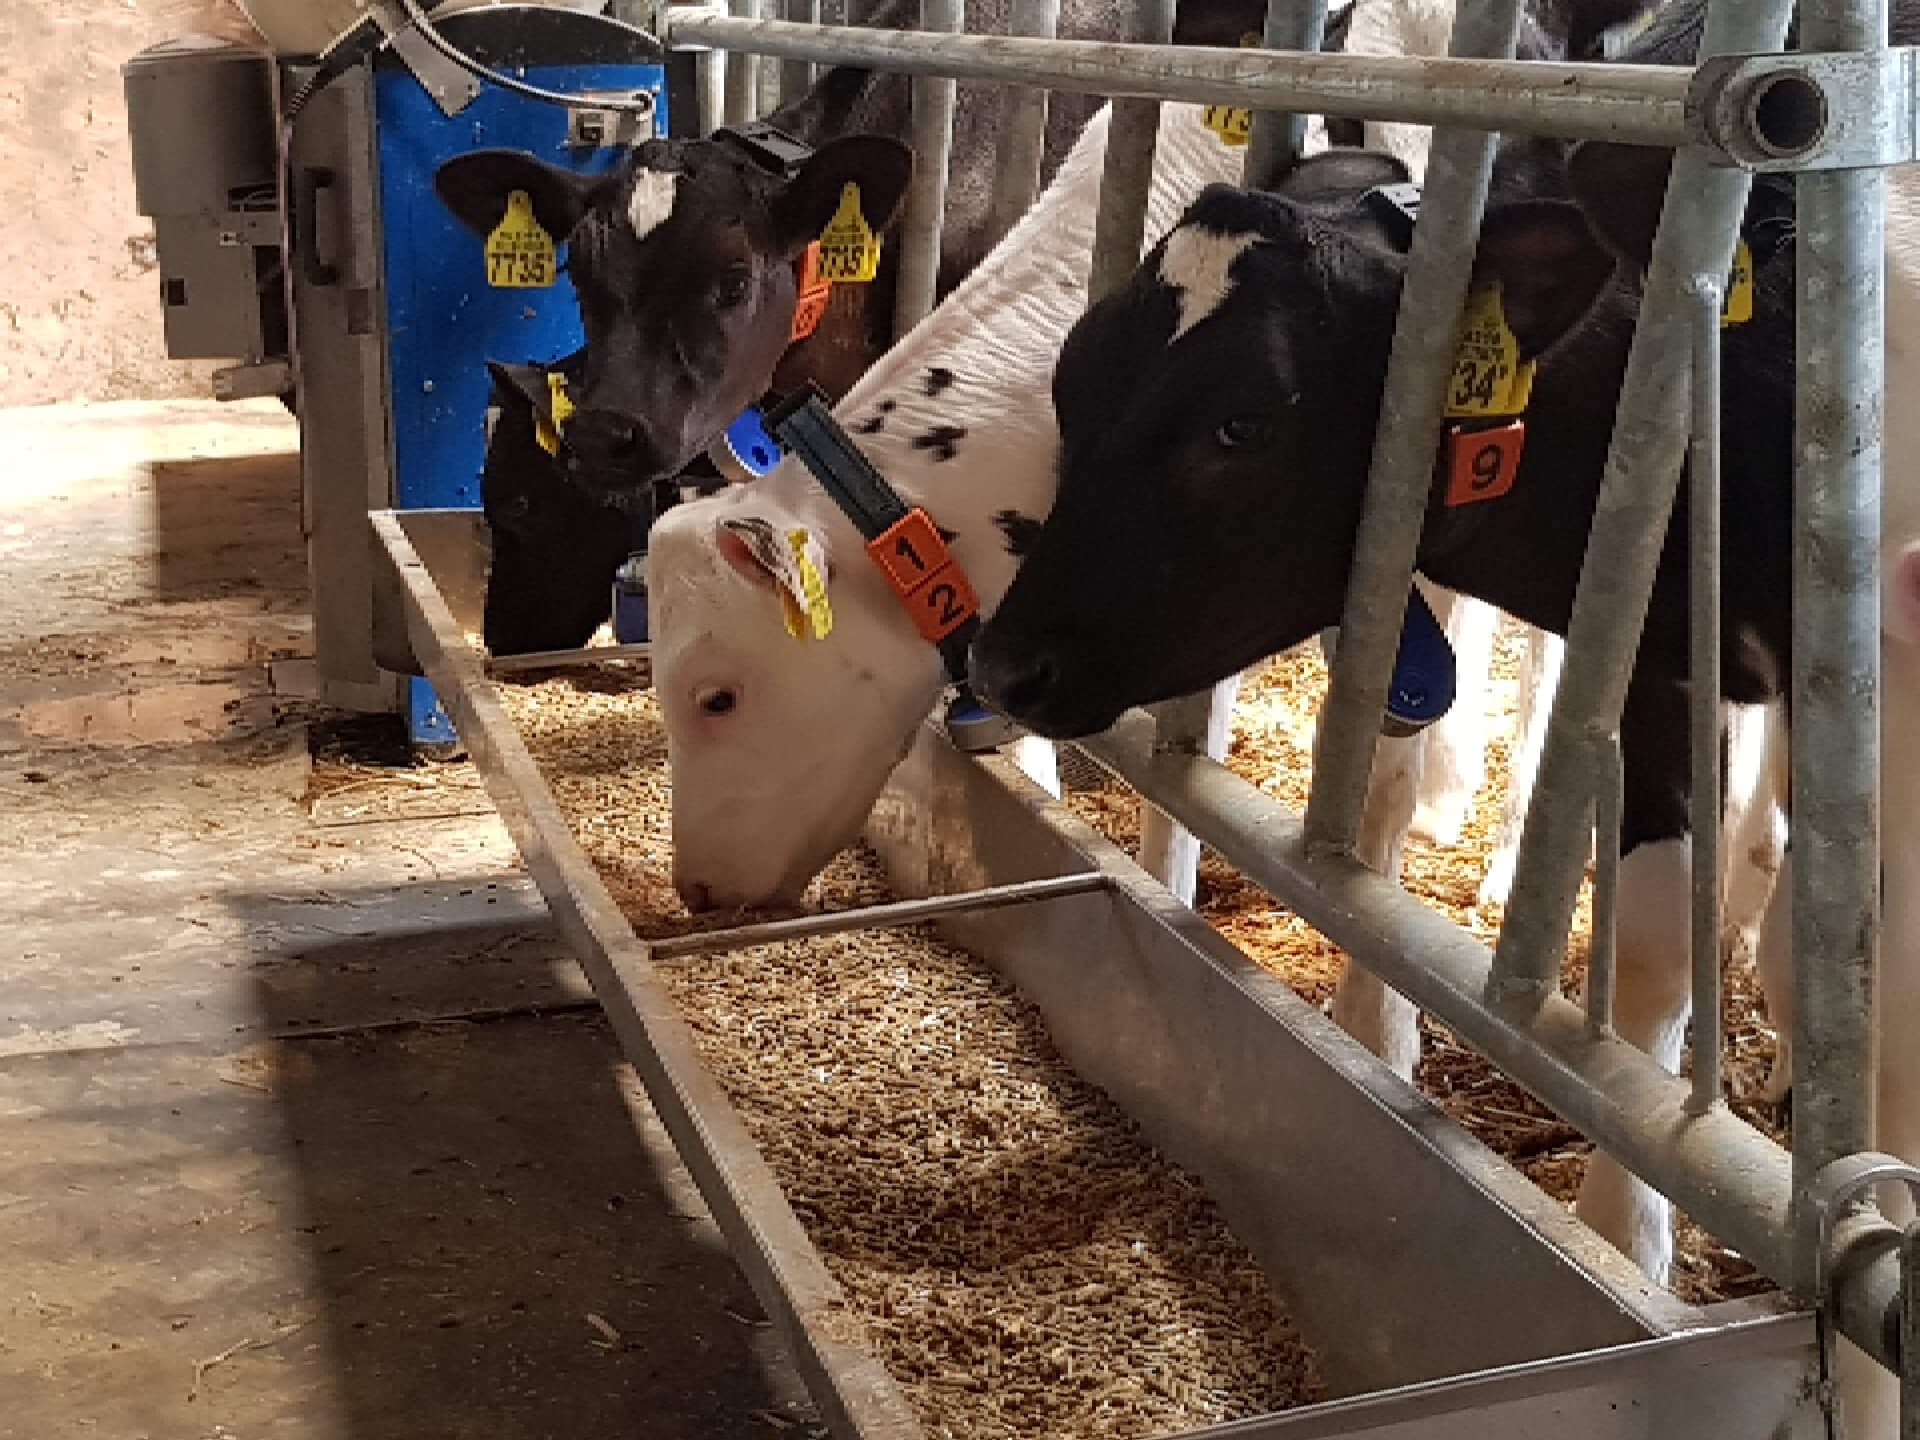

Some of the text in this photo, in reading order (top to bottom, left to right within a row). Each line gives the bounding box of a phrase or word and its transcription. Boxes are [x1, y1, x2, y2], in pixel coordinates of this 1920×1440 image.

[488, 252, 545, 283] 7735
[1453, 361, 1500, 409] 34
[1471, 444, 1504, 491] 9
[896, 536, 964, 625] 1 2
